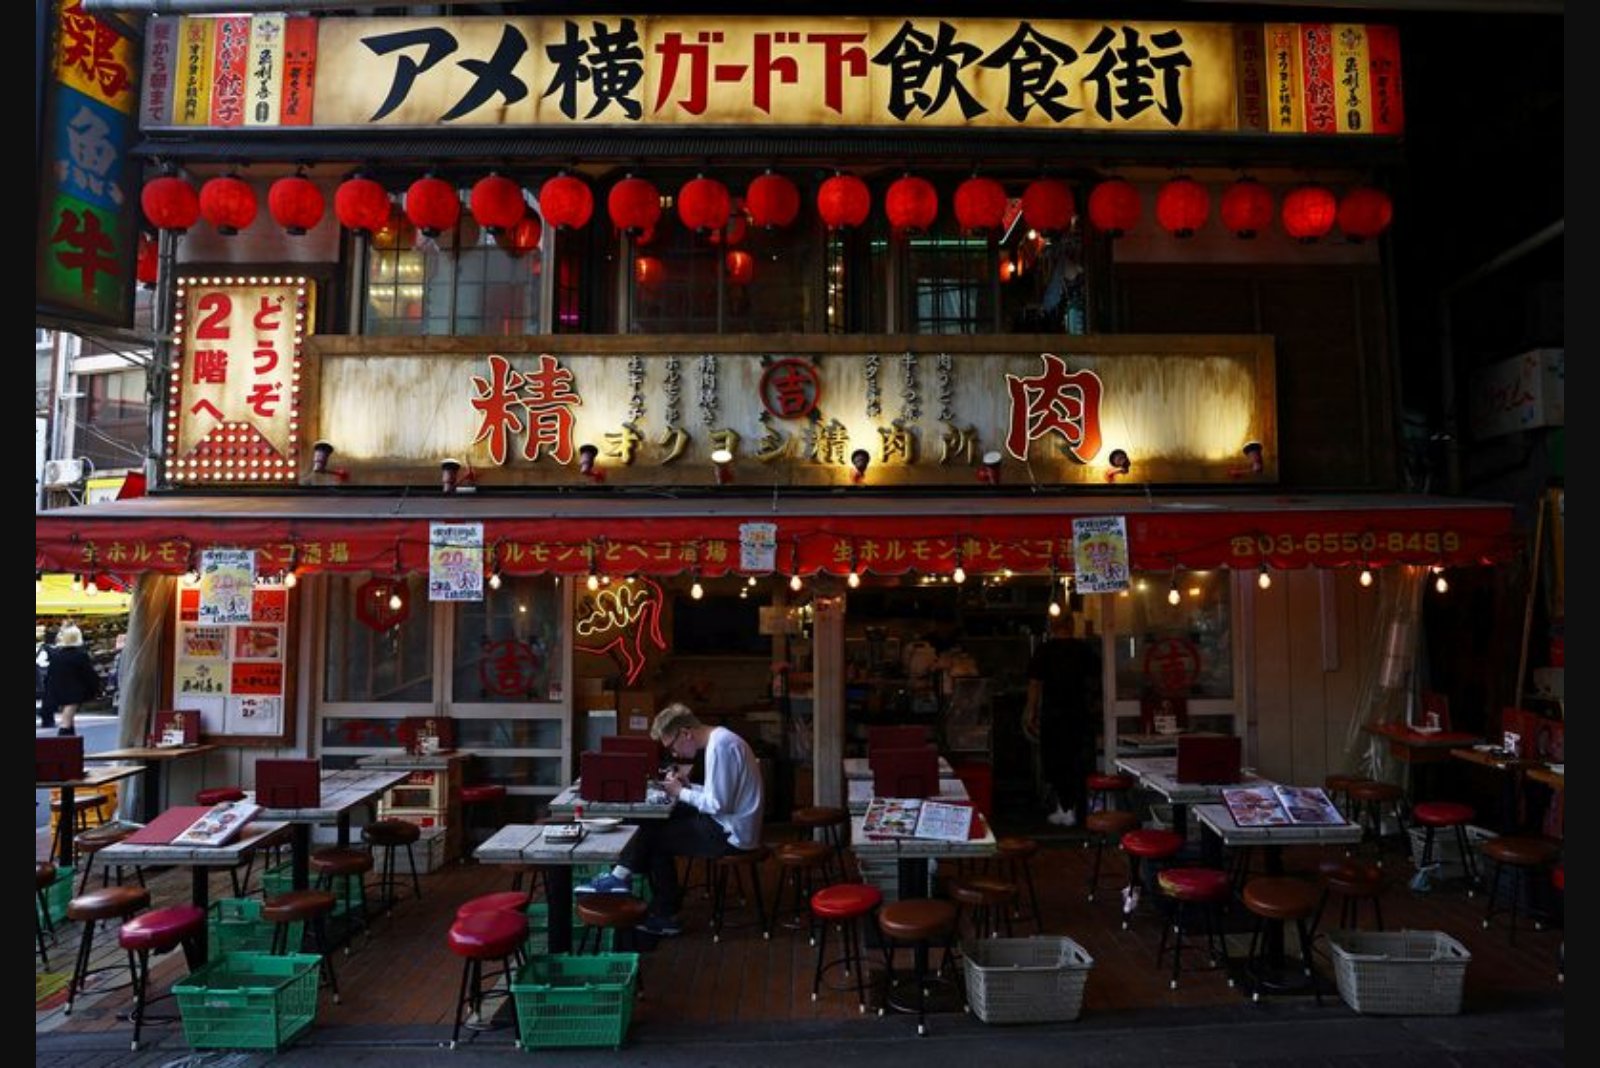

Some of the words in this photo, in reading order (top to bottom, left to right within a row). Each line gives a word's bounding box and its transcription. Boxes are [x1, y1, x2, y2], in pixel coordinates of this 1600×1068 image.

[359, 19, 1193, 127] アメ横ガード下飲食街
[51, 209, 123, 298] 牛
[190, 293, 233, 421] 2階へ
[247, 296, 286, 417] どうぞ
[471, 353, 584, 466] 精
[1005, 353, 1104, 463] 肉
